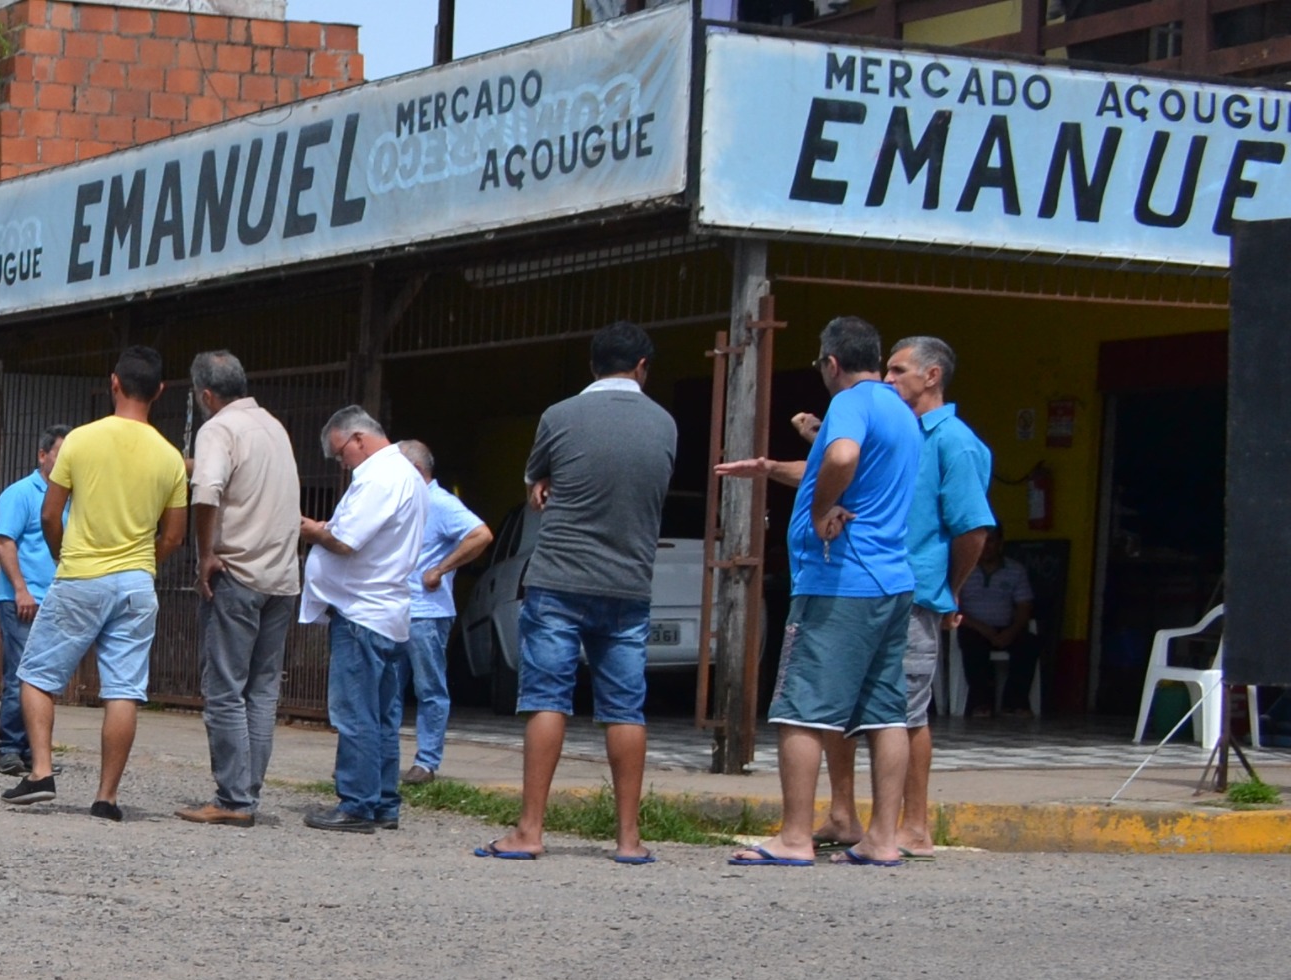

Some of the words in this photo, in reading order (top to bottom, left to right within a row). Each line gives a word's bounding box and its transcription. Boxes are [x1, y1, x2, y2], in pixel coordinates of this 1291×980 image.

[396, 69, 543, 138] MERCADO
[825, 52, 1052, 111] MERCADO
[1096, 81, 1291, 133] AÇOUGU
[479, 112, 656, 191] AÇOUGUE
[67, 112, 366, 284] EMANUEL
